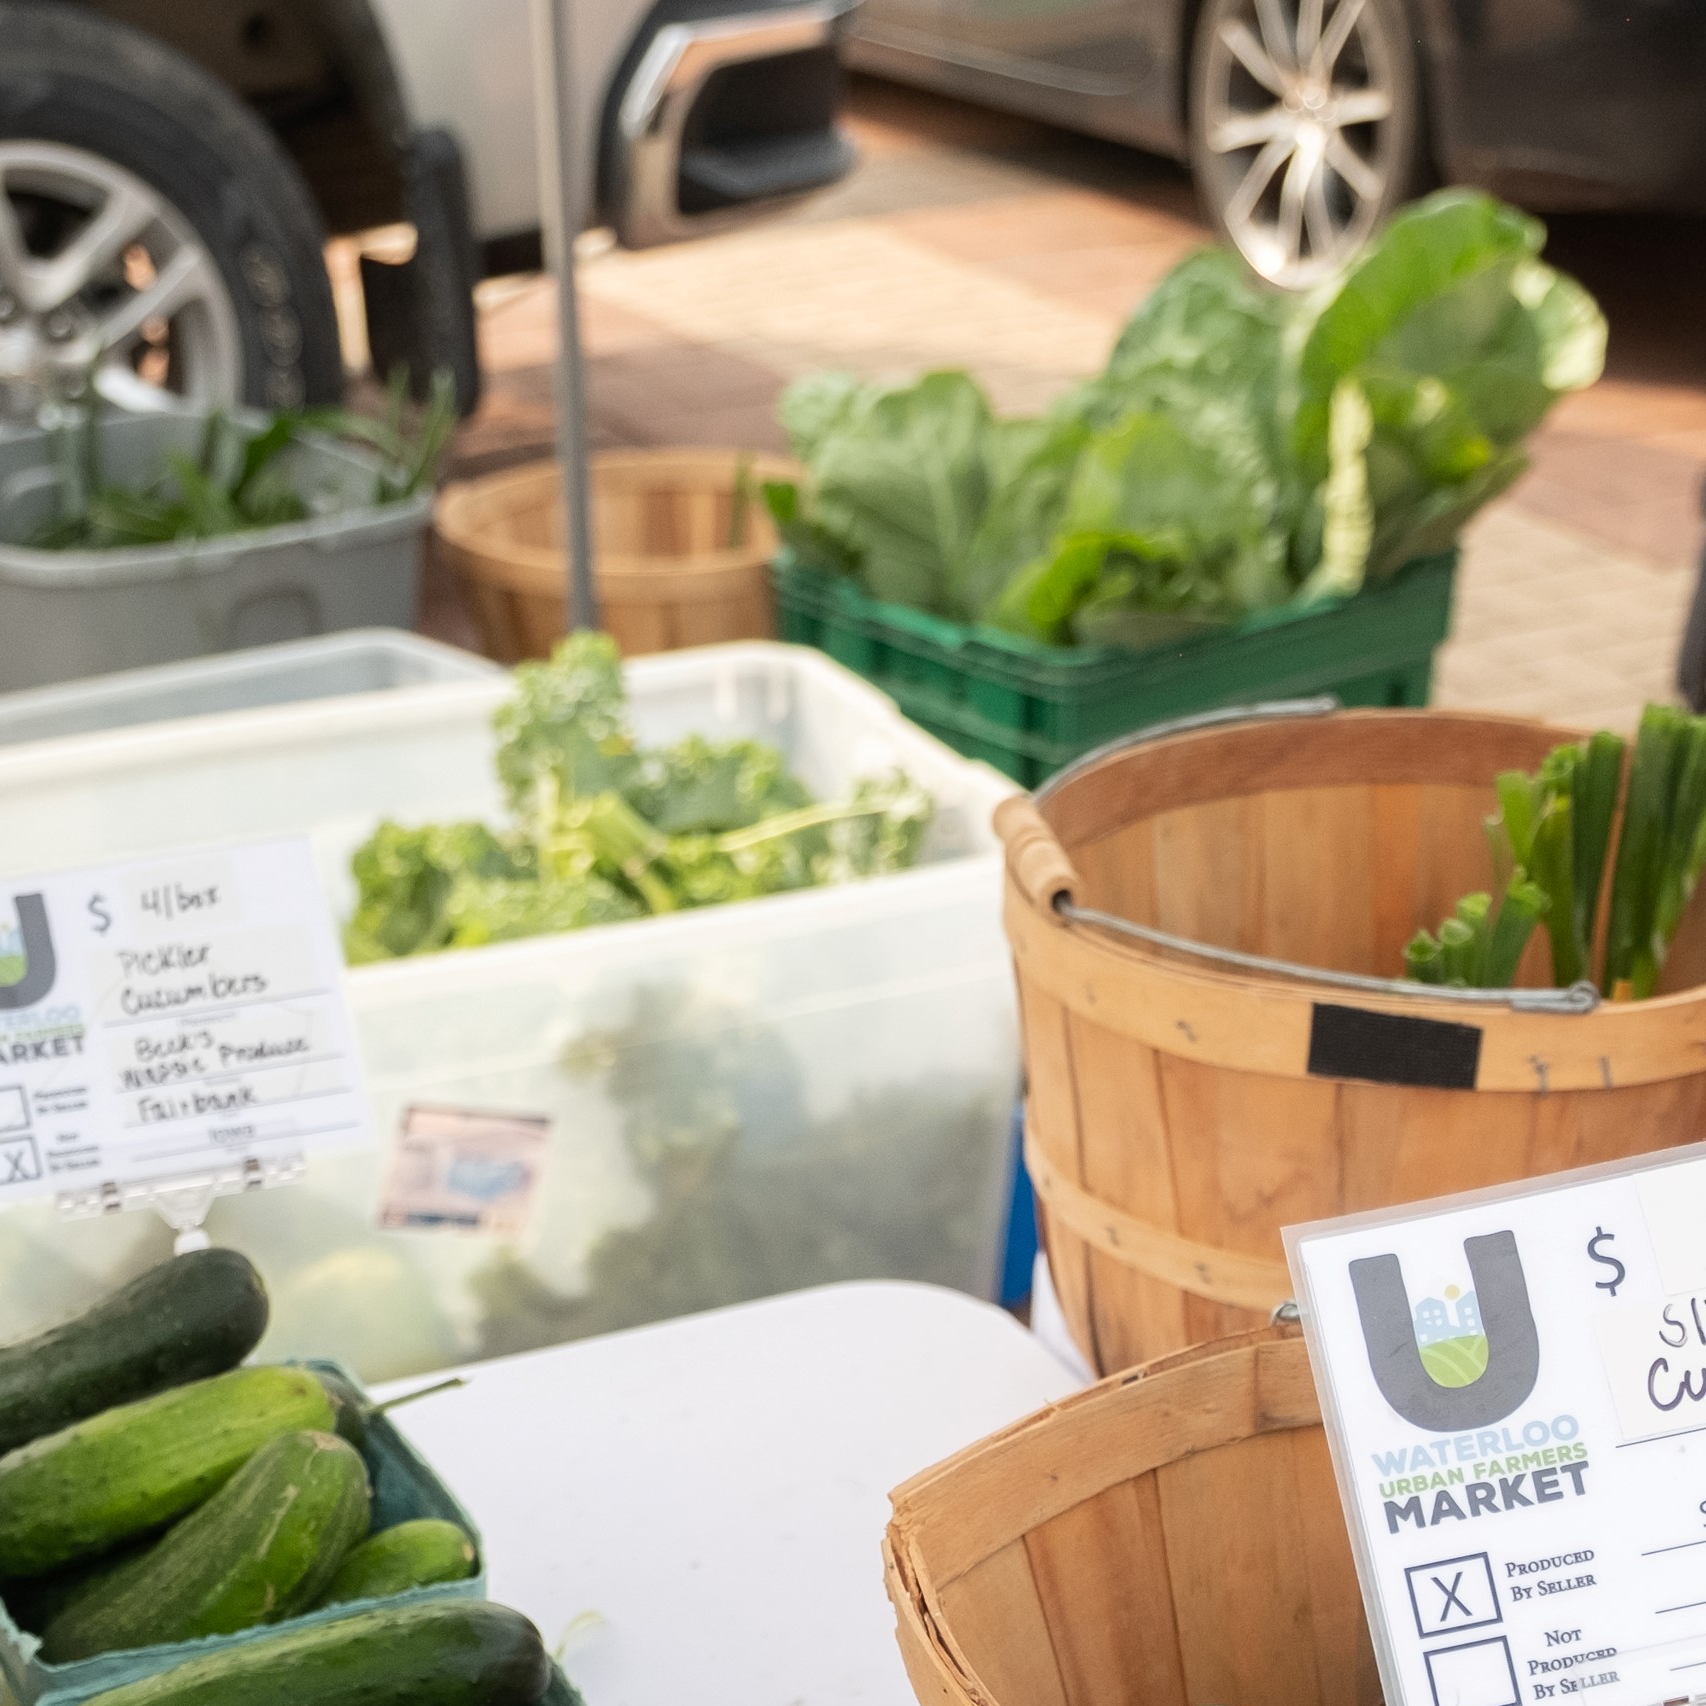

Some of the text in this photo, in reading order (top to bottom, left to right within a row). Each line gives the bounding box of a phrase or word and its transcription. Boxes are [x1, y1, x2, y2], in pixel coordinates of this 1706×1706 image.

[87, 892, 111, 936] $
[1587, 1226, 1625, 1297] $
[1370, 1414, 1580, 1477] WATERLOO
[1379, 1442, 1588, 1499] URBAN FARMERS
[1383, 1461, 1590, 1534] MARKET
